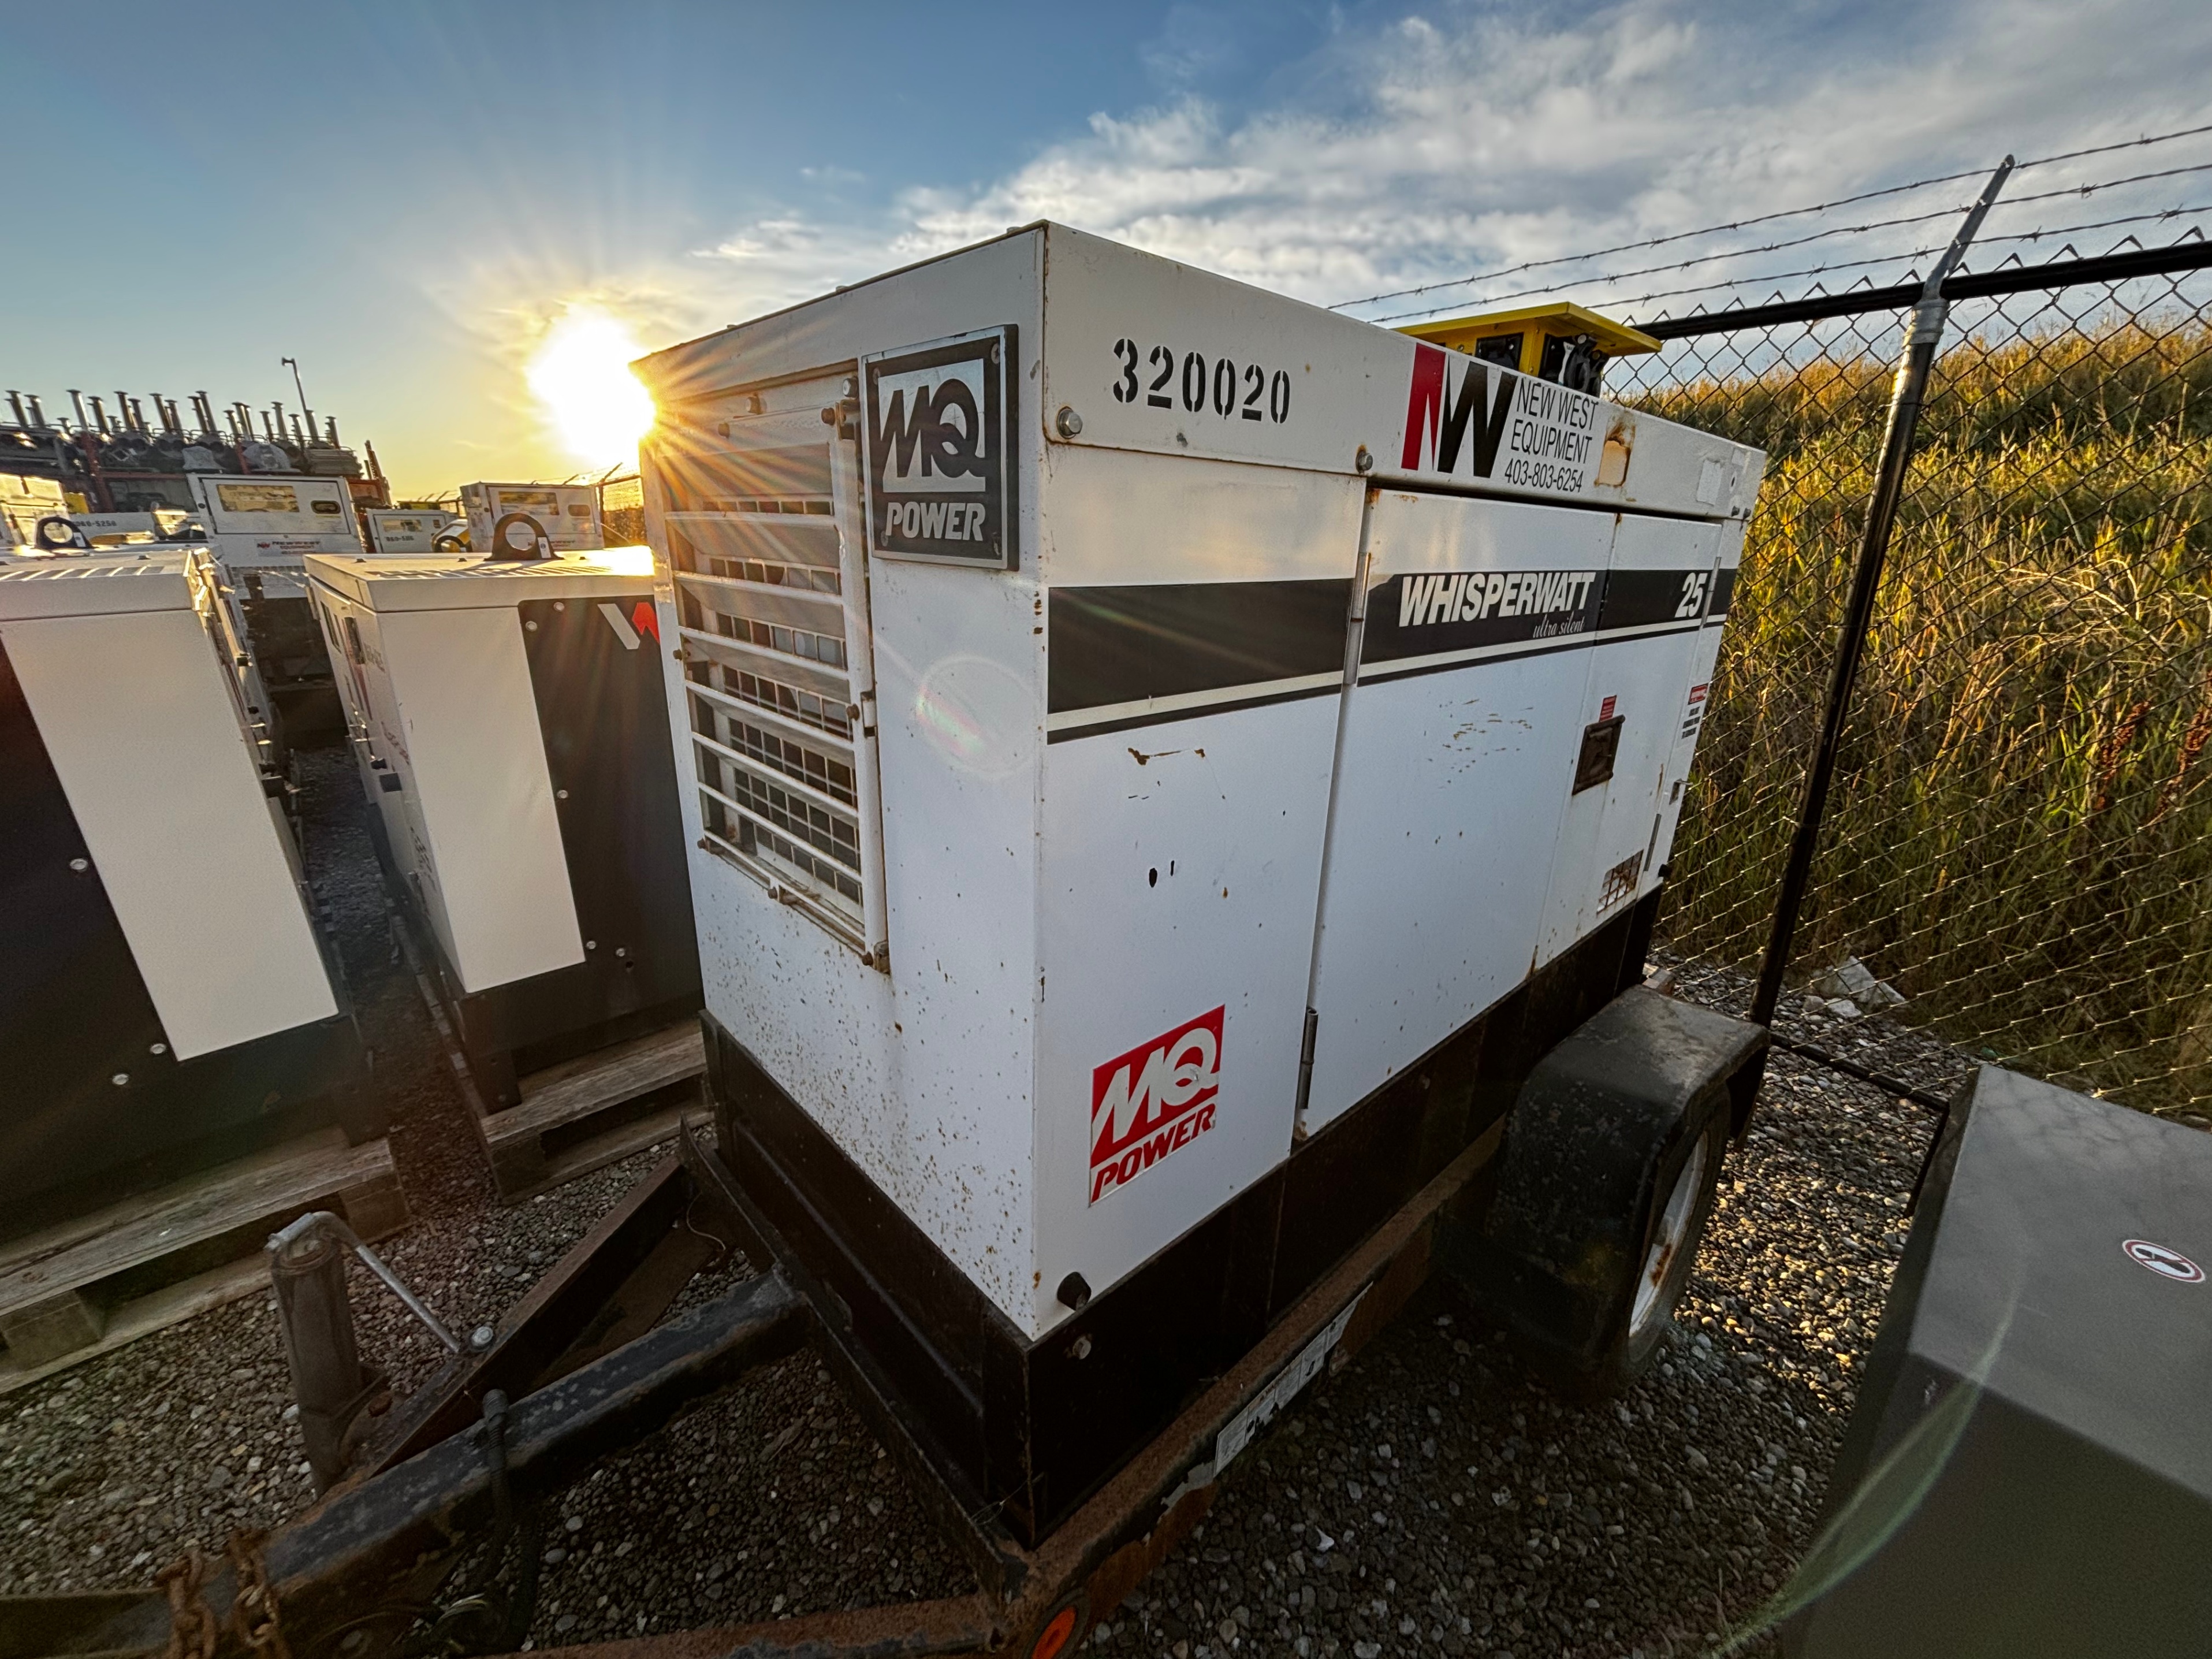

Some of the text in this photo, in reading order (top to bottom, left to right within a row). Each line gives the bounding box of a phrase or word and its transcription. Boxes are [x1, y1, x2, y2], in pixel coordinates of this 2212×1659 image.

[1113, 339, 1290, 424] 320020
[1517, 378, 1599, 430] NEW WEST
[880, 378, 986, 478] MQ
[1511, 419, 1592, 464] EQUIPMENT
[1505, 458, 1584, 493] 403-803-6254
[885, 502, 986, 542] POWER
[1399, 572, 1596, 627] WHISPERWATT
[1674, 572, 1708, 619] 25
[1532, 611, 1585, 638] ultra silent
[1092, 1027, 1220, 1155] MQ
[1090, 1103, 1216, 1204] POWER
